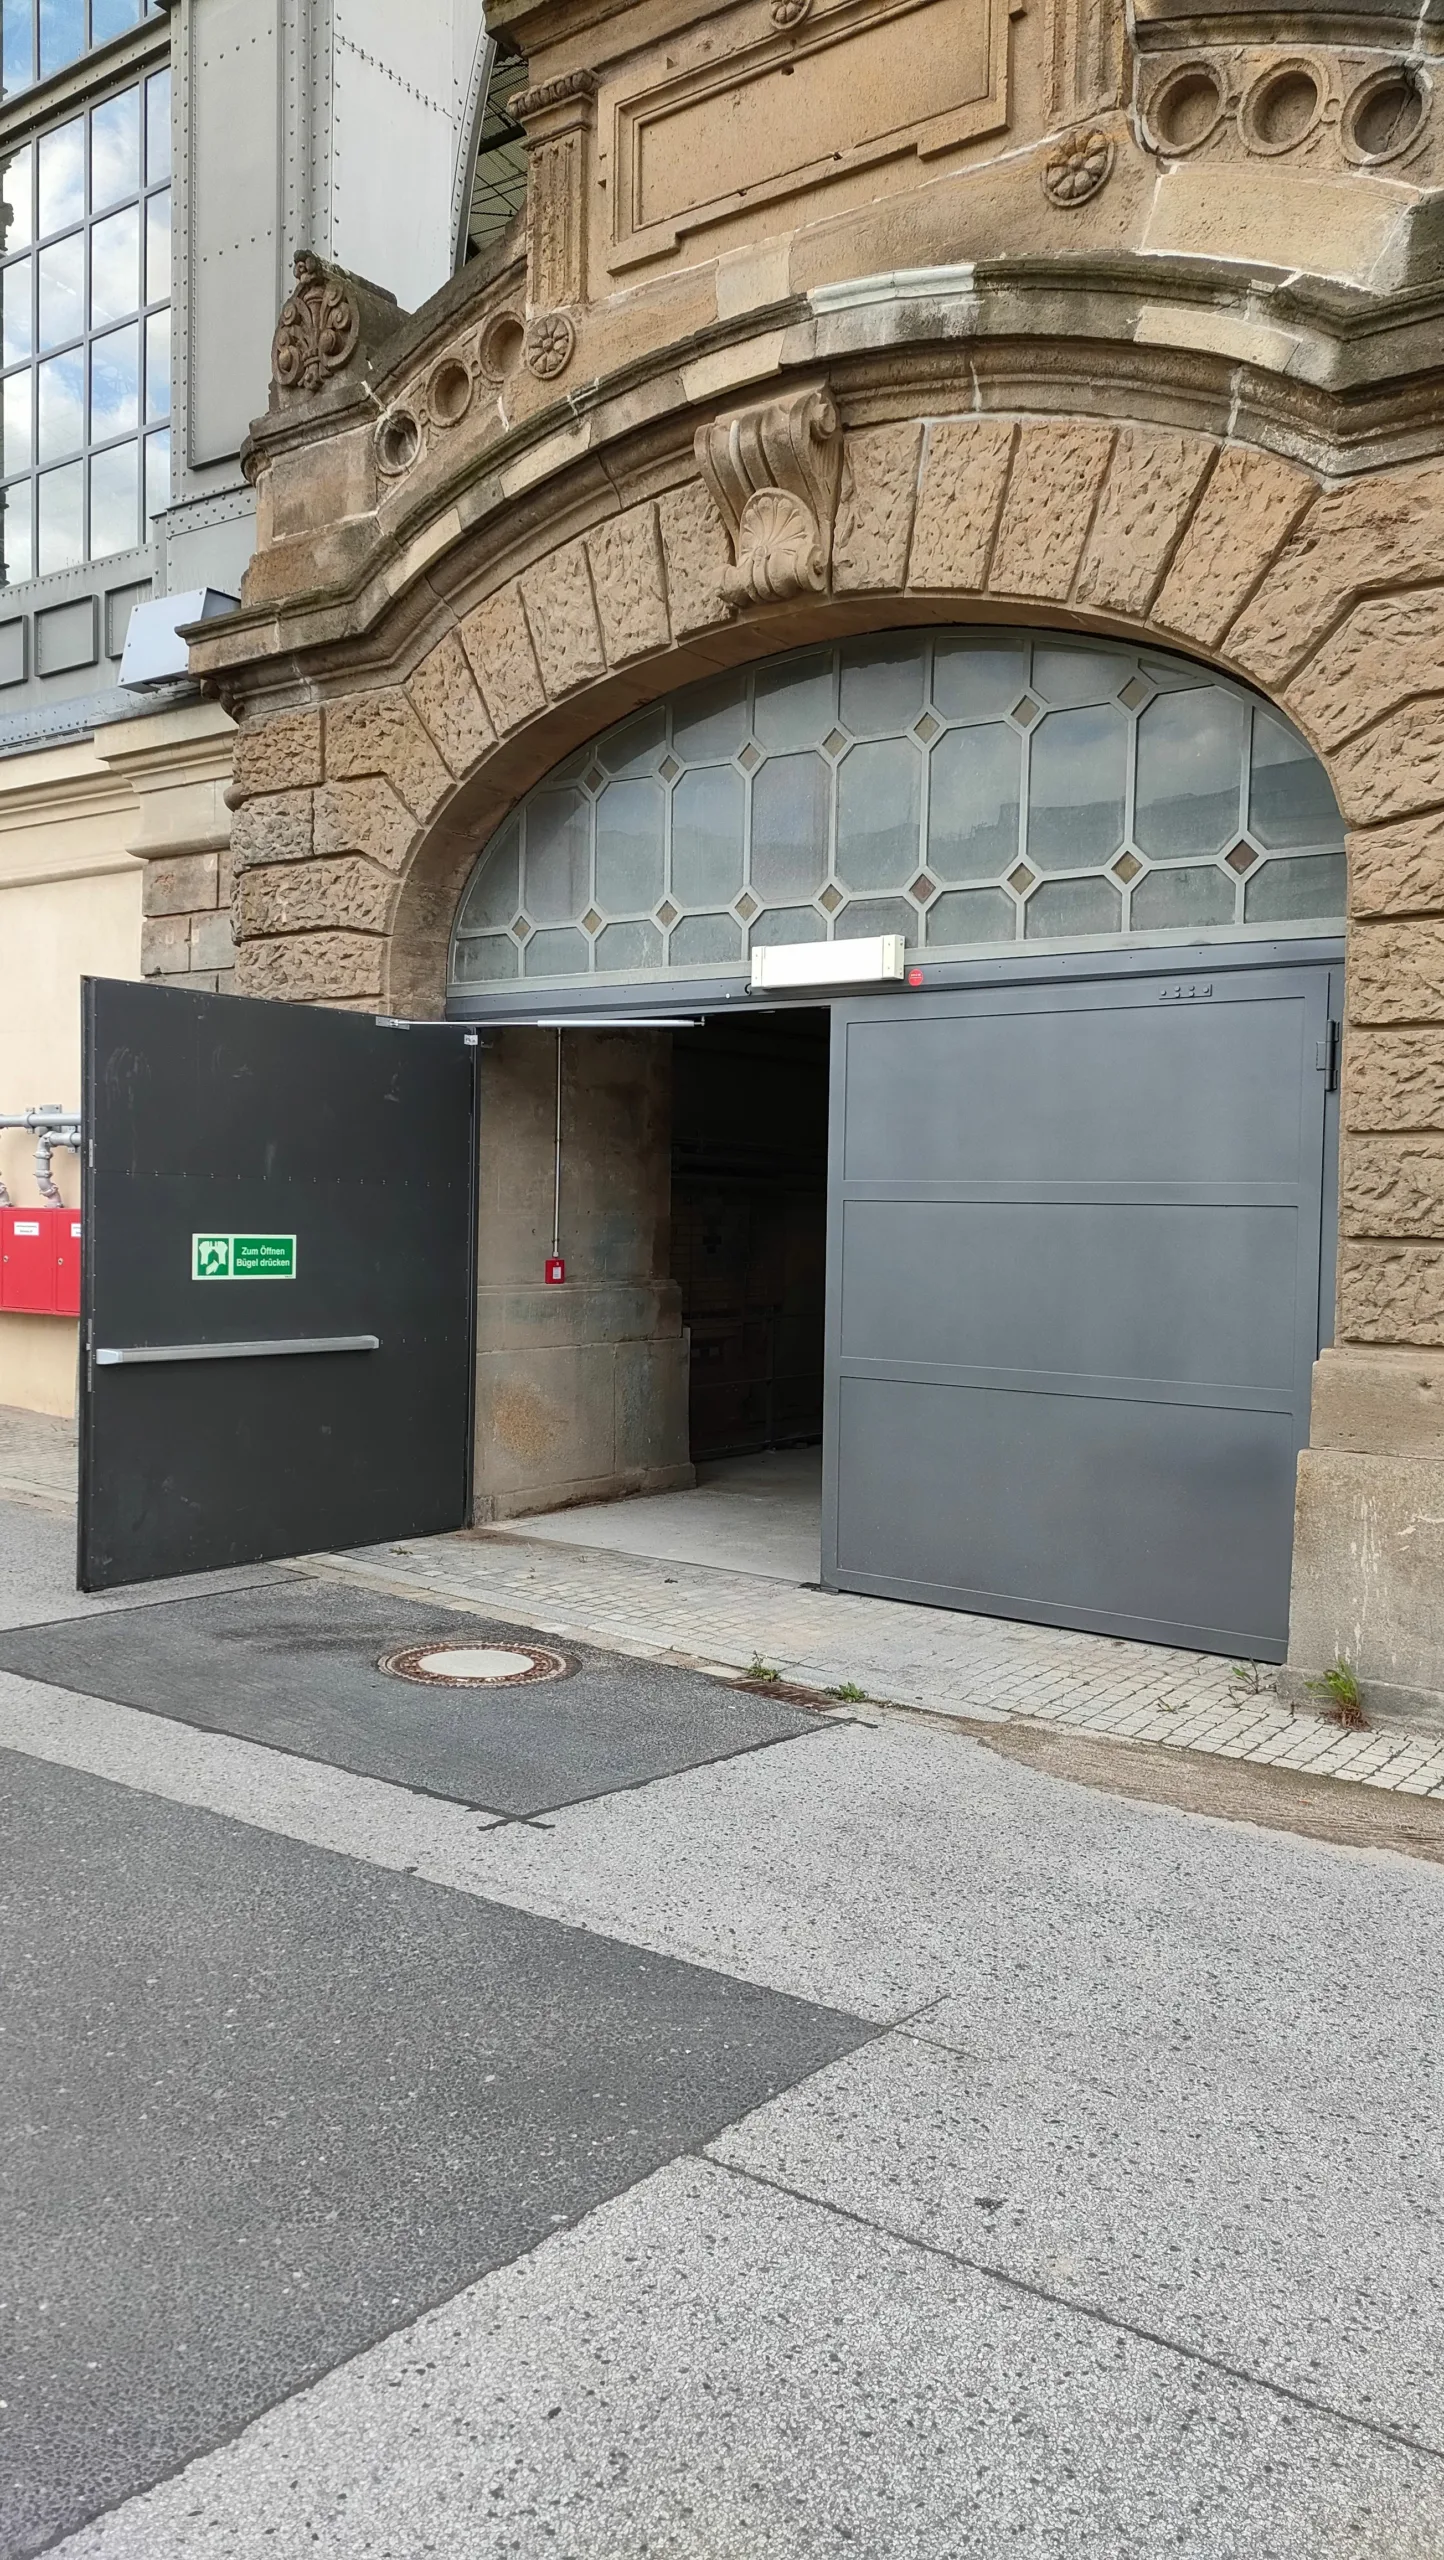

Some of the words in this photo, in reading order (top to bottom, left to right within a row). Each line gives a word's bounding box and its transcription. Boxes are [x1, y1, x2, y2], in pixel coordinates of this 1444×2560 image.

[241, 1246, 259, 1255] Zum
[260, 1245, 285, 1255] Öffnen
[236, 1258, 259, 1268] Bügel
[259, 1258, 290, 1267] drücken
